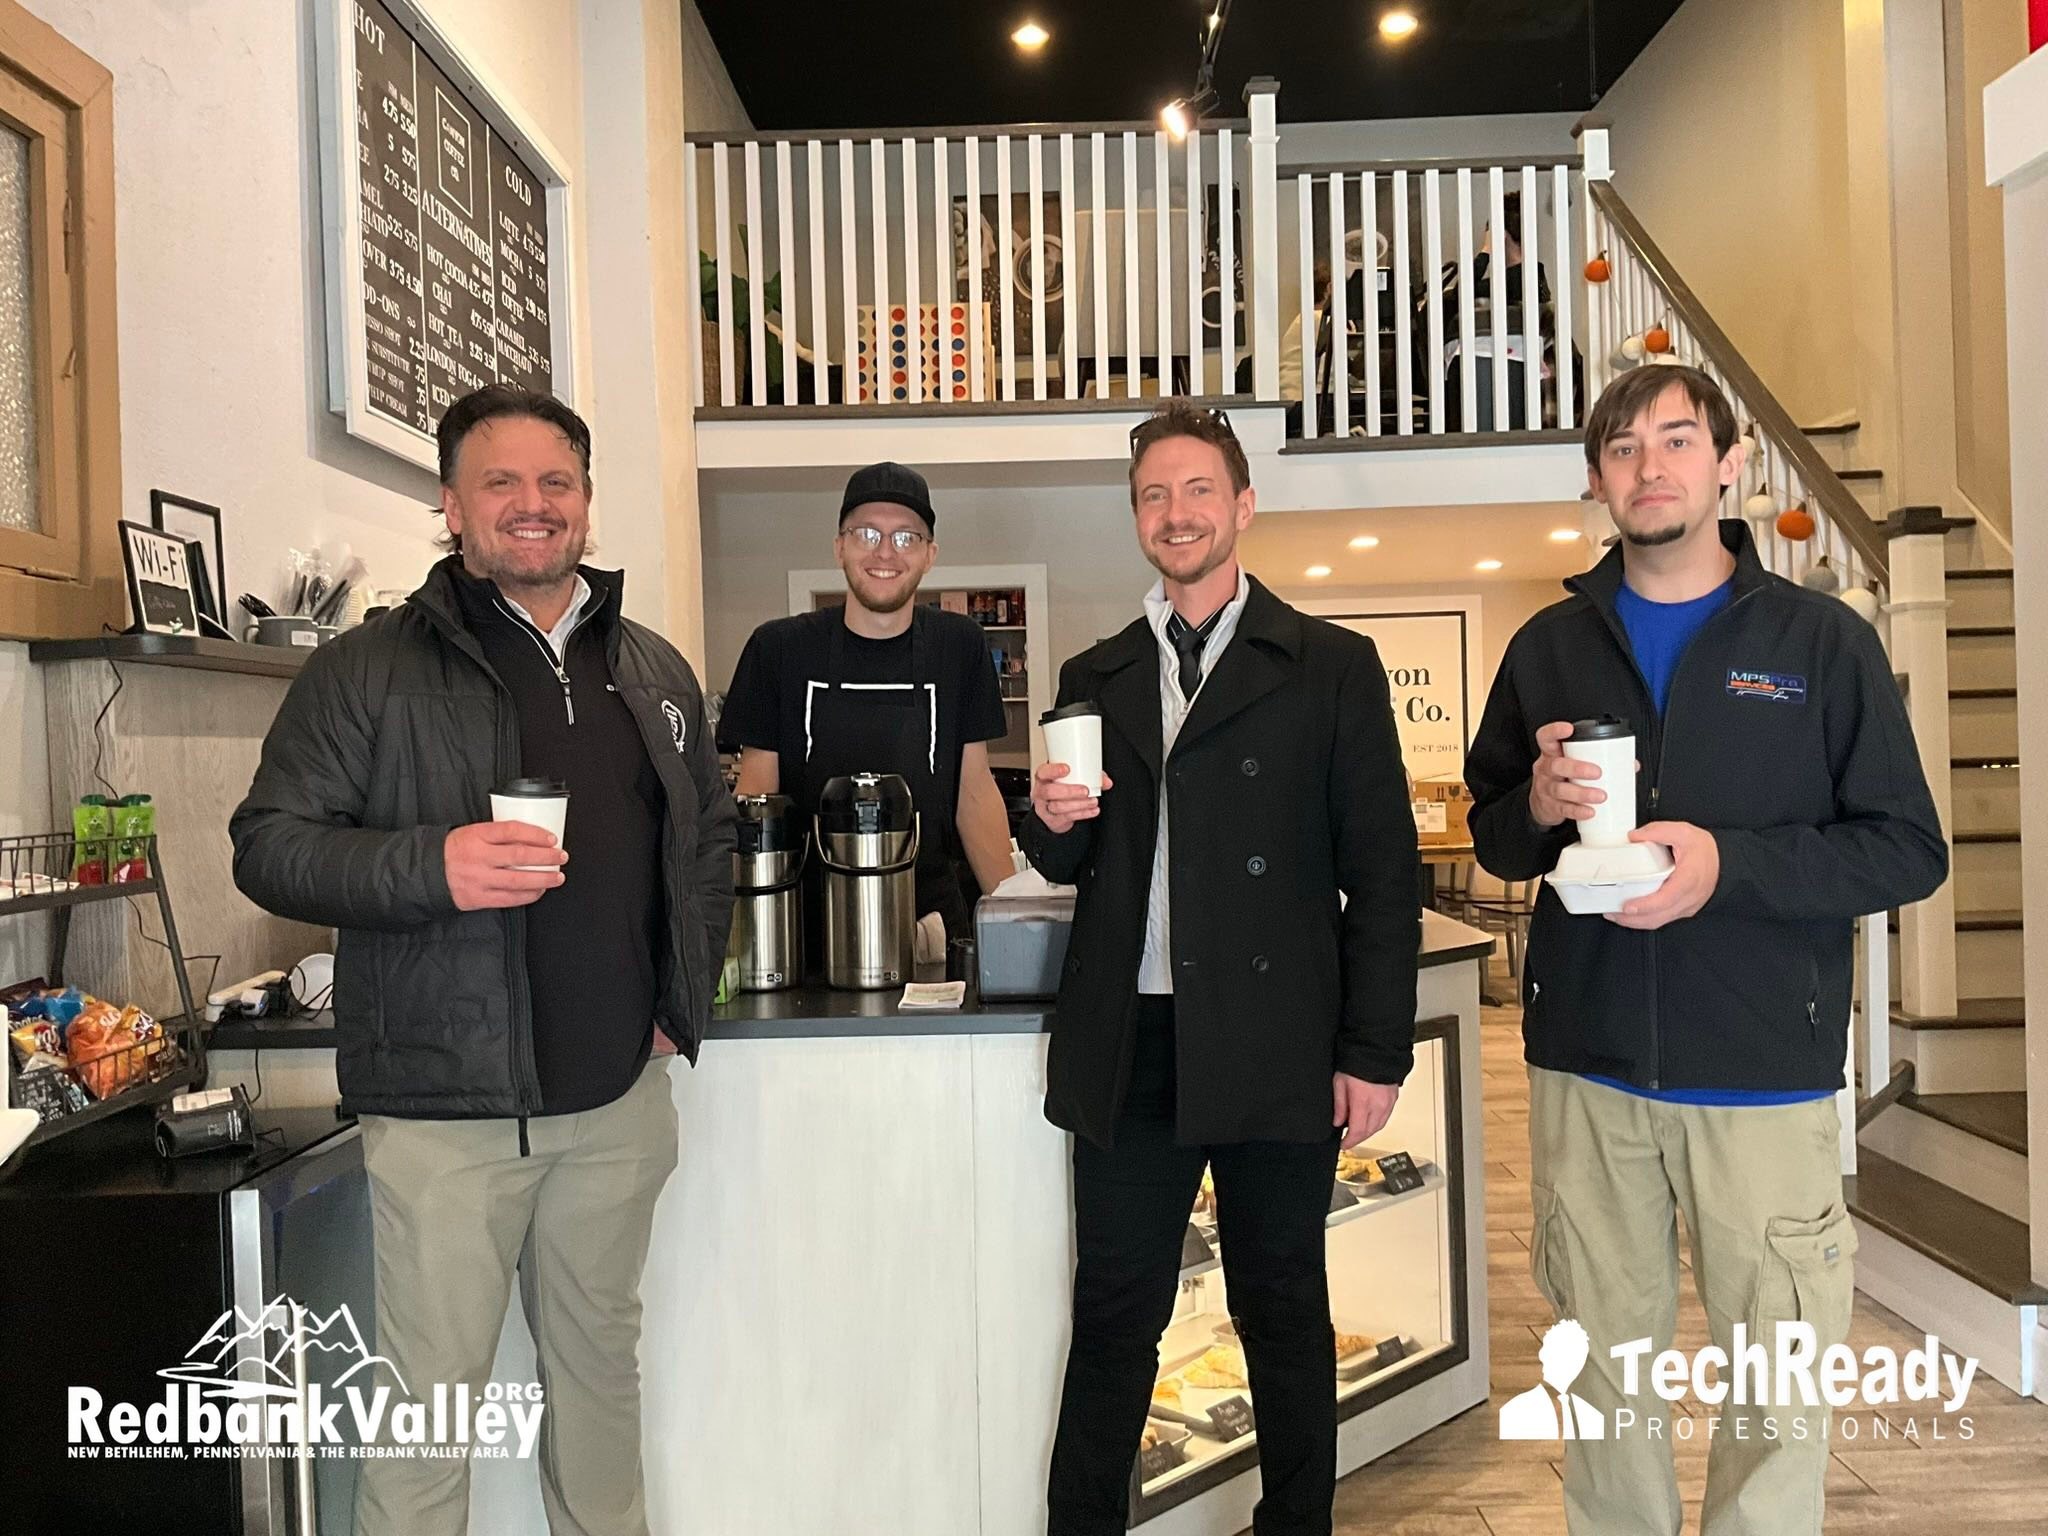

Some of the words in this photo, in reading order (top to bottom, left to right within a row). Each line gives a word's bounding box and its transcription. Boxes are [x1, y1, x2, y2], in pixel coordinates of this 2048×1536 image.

[353, 0, 385, 55] HOT
[387, 132, 394, 152] 5
[505, 165, 532, 207] COLD
[361, 202, 388, 238] HIATO
[422, 189, 492, 268] ALTERNATIVES
[499, 210, 520, 243] LATTE
[427, 243, 444, 270] HOT
[363, 281, 400, 321] DD-ONS
[432, 281, 453, 309] CHAI
[428, 311, 445, 338] HOT
[447, 324, 464, 350] TEA
[426, 343, 457, 377] LONDON
[133, 534, 187, 584] Wi-Fi
[1406, 696, 1450, 723] Co.
[1413, 744, 1434, 753] EST
[1437, 744, 1459, 753] 2018
